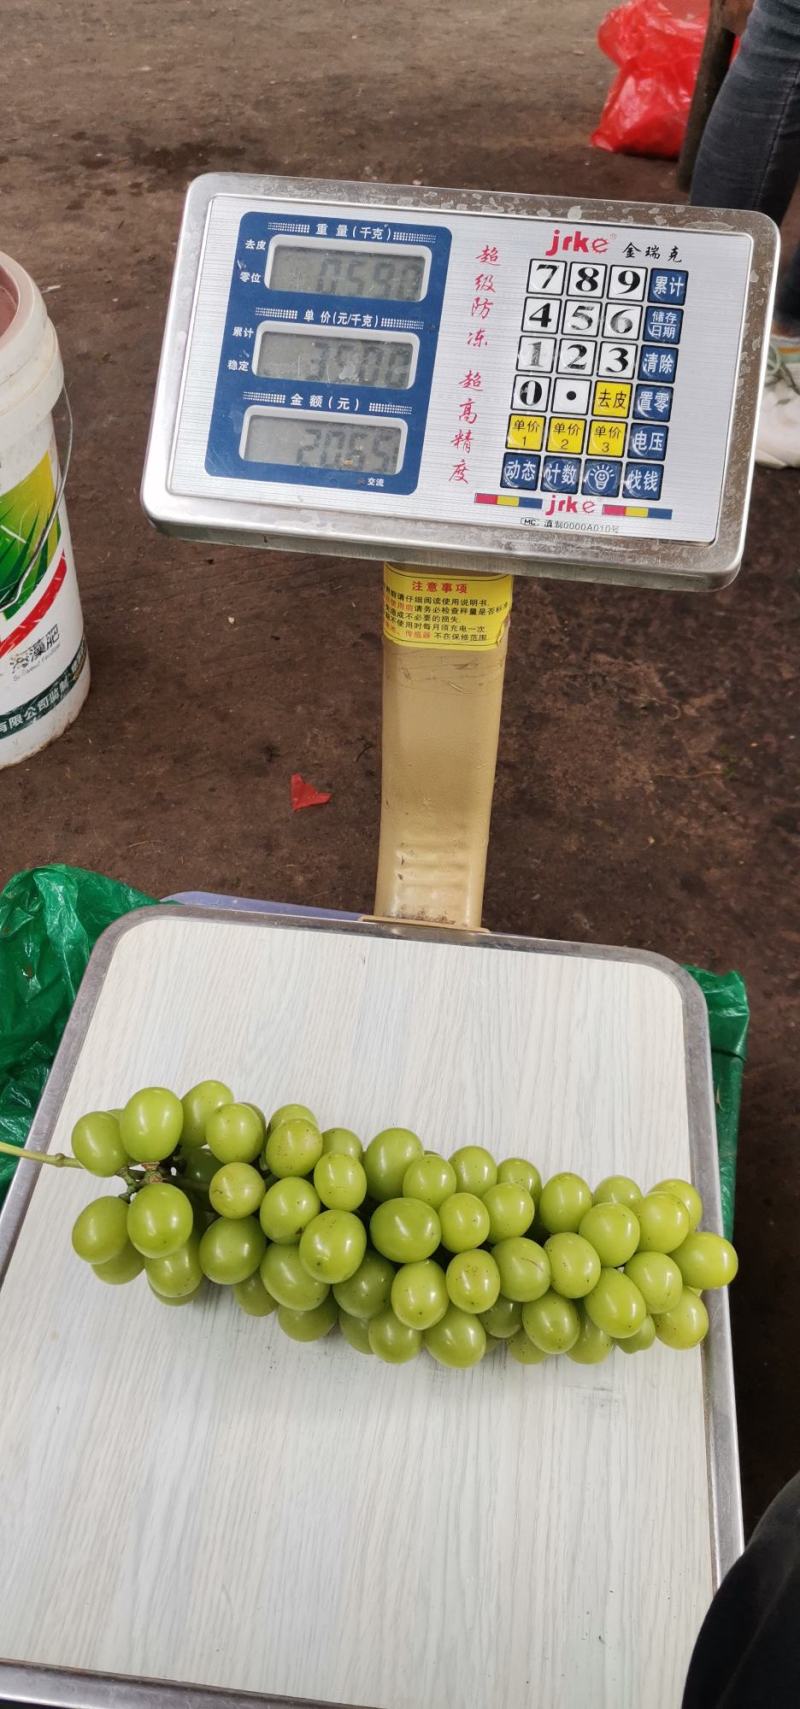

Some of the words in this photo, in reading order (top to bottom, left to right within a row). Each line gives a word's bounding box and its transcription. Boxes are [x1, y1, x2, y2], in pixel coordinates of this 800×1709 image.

[245, 240, 266, 251] 去皮
[545, 229, 609, 256] jrke
[622, 242, 683, 263] 金瑞克
[240, 271, 261, 284] 零位
[535, 264, 557, 290] 7
[575, 267, 599, 292] 8
[617, 270, 641, 294] 9
[653, 277, 685, 297] 累计
[466, 245, 501, 348] 超级防冻
[528, 302, 552, 328] 4
[571, 305, 594, 331] 5
[610, 308, 634, 334] 6
[651, 311, 677, 325] 储存
[232, 326, 254, 339] 累计
[651, 325, 676, 339] 日期
[527, 341, 543, 367] 1
[566, 344, 588, 371] 2
[605, 347, 629, 373] 3
[643, 353, 674, 374] 清除
[227, 360, 250, 372] 稳定
[519, 380, 543, 406] 0
[597, 389, 627, 409] 去皮
[638, 392, 670, 413] 置零
[448, 370, 484, 484] 超高精度
[512, 419, 539, 433] 单价
[553, 422, 580, 437] 单价
[594, 425, 621, 441] 单价
[560, 439, 568, 450] 2
[601, 442, 610, 453] 3
[633, 431, 664, 452] 电压
[367, 477, 384, 487] 交流
[505, 461, 536, 482] 动态
[545, 464, 577, 485] 计数
[627, 471, 659, 492] 找钱
[545, 495, 595, 515] jrke
[412, 581, 468, 593] 注意事项
